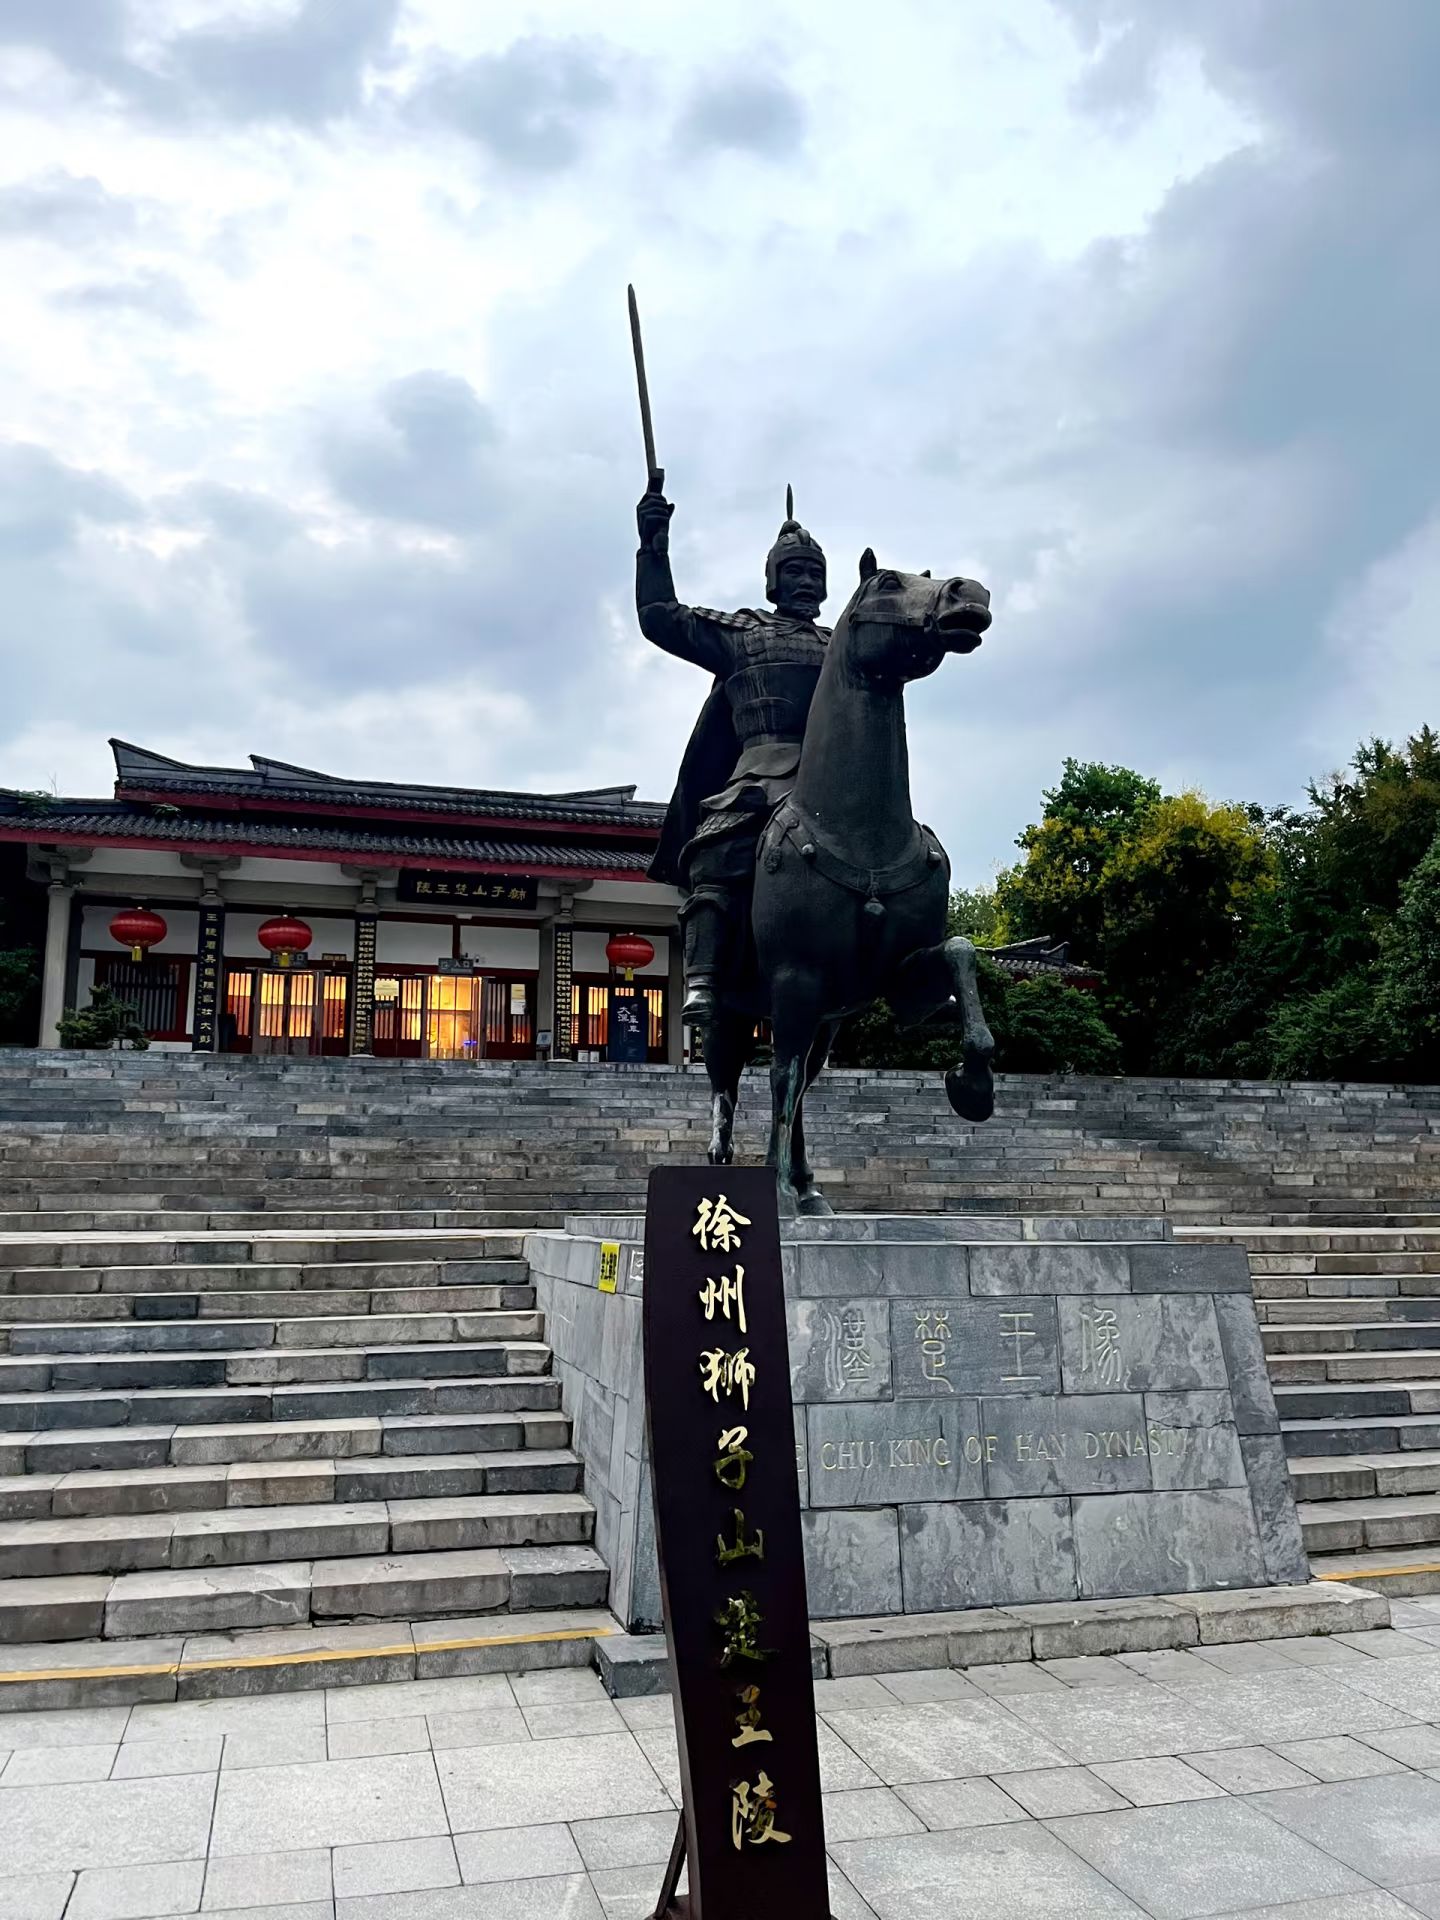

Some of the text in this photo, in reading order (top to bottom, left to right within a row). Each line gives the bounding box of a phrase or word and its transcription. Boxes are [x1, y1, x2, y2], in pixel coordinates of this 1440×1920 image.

[820, 1440, 874, 1470] CHU
[887, 1436, 951, 1468] KING
[963, 1435, 999, 1464] OF
[1015, 1430, 1067, 1462] HAN
